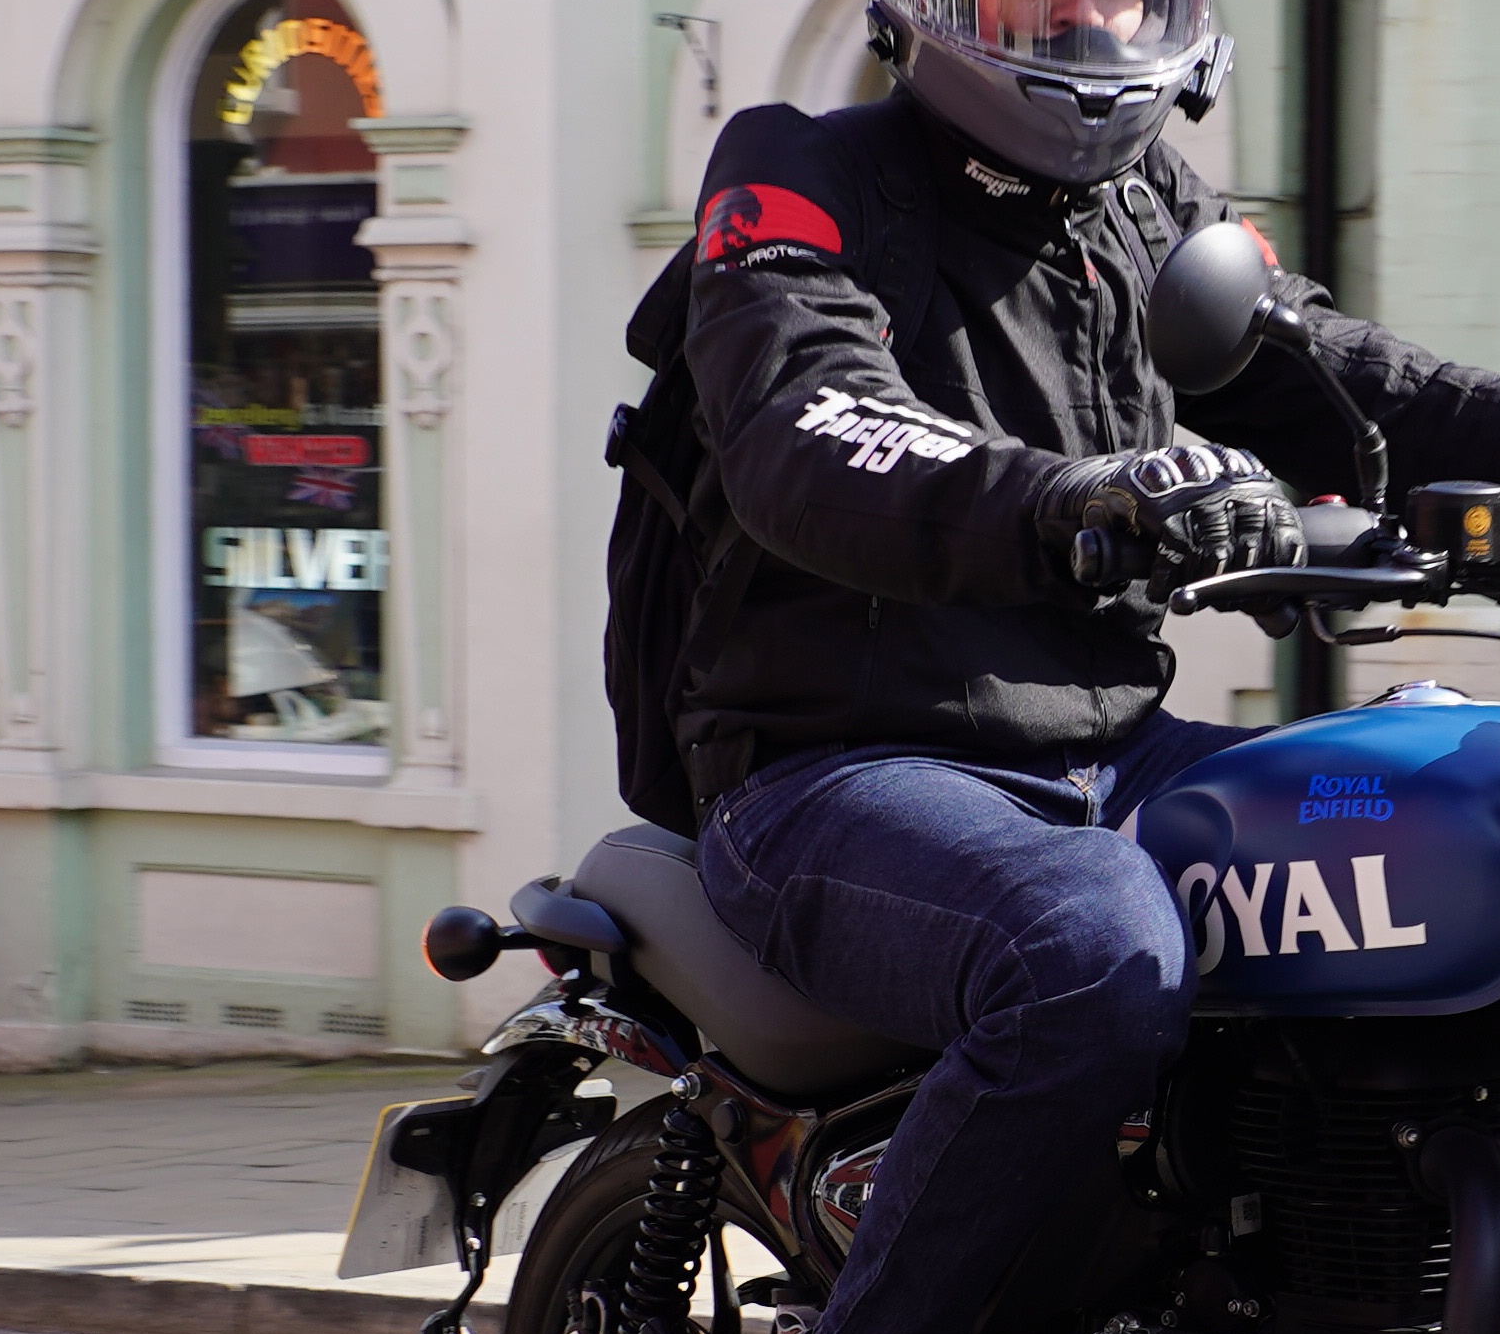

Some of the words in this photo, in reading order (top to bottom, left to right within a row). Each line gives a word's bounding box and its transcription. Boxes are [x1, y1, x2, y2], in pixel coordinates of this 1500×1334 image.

[1308, 774, 1385, 798] ROYAL
[1298, 798, 1395, 824] ENFIELD
[1174, 854, 1427, 976] OYAL
